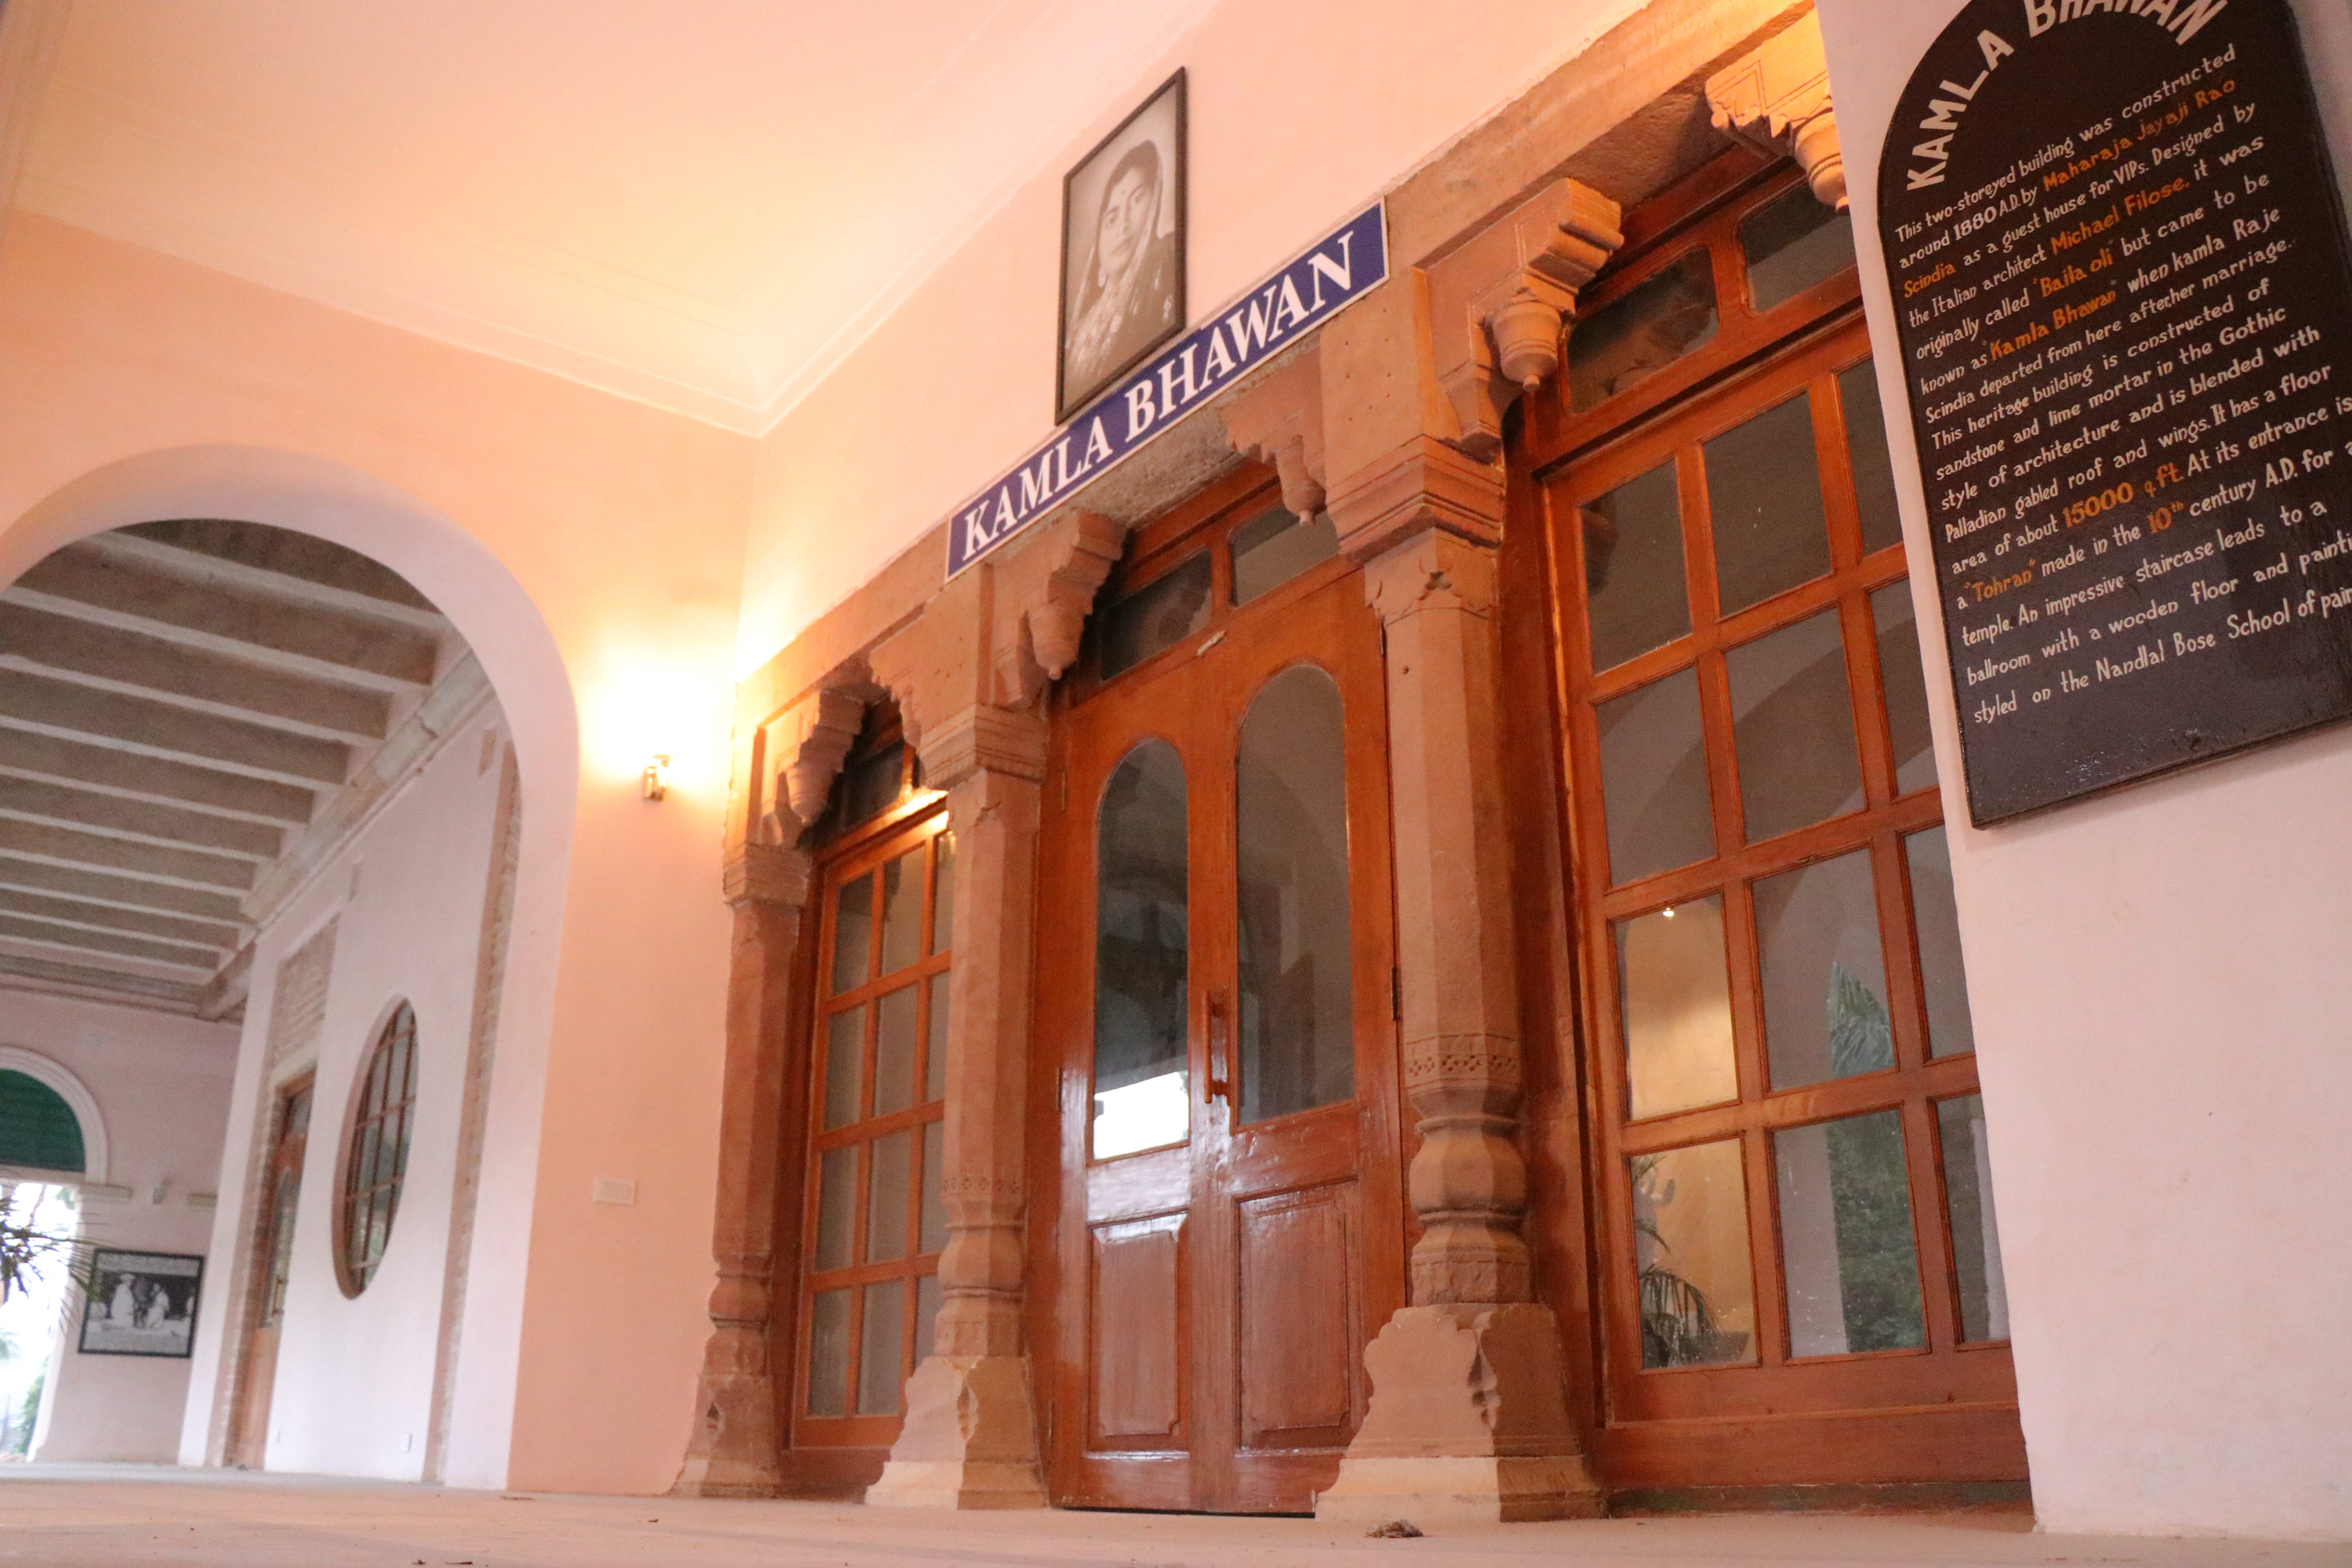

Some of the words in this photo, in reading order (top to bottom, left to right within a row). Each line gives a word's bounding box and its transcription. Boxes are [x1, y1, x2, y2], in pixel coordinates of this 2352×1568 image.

[1895, 222, 1922, 242] This
[1926, 165, 2016, 226] two-storeyed
[2018, 137, 2074, 176] building
[2079, 118, 2112, 141] was
[2122, 43, 2235, 118] constructed
[1900, 230, 1950, 269] around
[1953, 206, 1997, 240] 1880
[2020, 187, 2037, 206] by
[2043, 138, 2133, 191] Maharaja
[2138, 105, 2188, 140] Jayaji
[2195, 80, 2235, 107] Rao
[1907, 29, 2015, 191] KAMLA
[1904, 263, 1956, 298] Scindia
[1964, 250, 1981, 265] as
[1986, 243, 1999, 254] a
[2002, 213, 2041, 253] guest
[2043, 194, 2086, 223] house
[2089, 179, 2113, 198] for
[2113, 161, 2149, 184] VIPs.
[2152, 114, 2224, 165] Designed
[2234, 103, 2255, 123] by
[1909, 309, 1929, 327] the
[1931, 287, 1976, 317] Italian
[1983, 244, 2047, 290] architect
[2051, 205, 2120, 254] Michael
[2194, 159, 2208, 180] it
[2219, 136, 2264, 165] was
[1916, 318, 1979, 359] originally
[1985, 288, 2029, 325] called
[2121, 228, 2151, 256] but
[2158, 207, 2204, 237] came
[2214, 189, 2235, 209] to
[2244, 174, 2269, 194] be
[1921, 366, 1964, 395] known
[1971, 354, 1987, 369] as
[2127, 264, 2169, 293] when
[2233, 209, 2279, 240] Raje
[1926, 392, 1975, 423] Scindia
[1980, 353, 2043, 397] departed
[2047, 341, 2082, 364] from
[2085, 321, 2122, 345] here
[1931, 428, 1962, 449] This
[1967, 397, 2029, 433] heritage
[2033, 364, 2093, 402] building
[2102, 355, 2118, 370] is
[2127, 294, 2234, 357] constructed
[2248, 278, 2269, 301] of
[962, 416, 1113, 561] KAMLA
[1124, 230, 1355, 443] BHAWAN
[1936, 440, 2004, 480] sandstone
[2013, 418, 2039, 443] and
[2049, 404, 2081, 426] lime
[2089, 370, 2152, 408] mortar
[2157, 361, 2173, 376] in
[2179, 343, 2213, 364] the
[2220, 308, 2286, 345] Gothic
[1942, 482, 1978, 510] style
[1989, 465, 2007, 487] of
[2013, 419, 2120, 476] architecture
[2129, 393, 2164, 423] and
[2169, 390, 2186, 405] is
[2190, 347, 2264, 395] blended
[2273, 326, 2320, 357] with
[1945, 508, 2006, 543] Palladian
[2015, 477, 2058, 519] gabled
[2068, 457, 2102, 488] roof
[2113, 439, 2147, 468] and
[2158, 419, 2211, 447] wings.
[2210, 404, 2227, 426] It
[2229, 397, 2259, 417] has
[2264, 390, 2276, 402] a
[2279, 365, 2331, 396] floor
[1952, 552, 1987, 574] area
[1995, 533, 2011, 555] of
[2016, 514, 2059, 546] about
[2062, 483, 2134, 527] 15000
[2188, 450, 2211, 476] At
[2216, 441, 2239, 463] its
[2249, 408, 2328, 449] entrance
[2336, 397, 2352, 415] is
[1957, 597, 1968, 609] a
[2042, 545, 2085, 577] made
[2093, 538, 2108, 555] in
[2113, 524, 2141, 546] the
[2190, 479, 2256, 516] century
[2301, 449, 2334, 472] for
[1962, 613, 2013, 646] temple.
[2019, 604, 2038, 626] An
[2045, 576, 2124, 615] impressive
[2136, 543, 2214, 582] staircase
[2216, 518, 2265, 550] leads
[2280, 506, 2303, 526] to
[2310, 501, 2327, 516] a
[1967, 655, 2031, 686] ballroom
[2042, 628, 2079, 657] with
[2089, 629, 2102, 640] a
[2108, 599, 2178, 633] wooden
[2190, 579, 2238, 604] floor
[2253, 552, 2288, 582] and
[1975, 690, 2017, 723] styled
[2033, 689, 2051, 702] on
[2061, 670, 2089, 692] the
[2096, 639, 2165, 681] Nandlal
[2173, 632, 2216, 656] Bose
[2227, 598, 2290, 639] School
[2298, 590, 2315, 617] of
